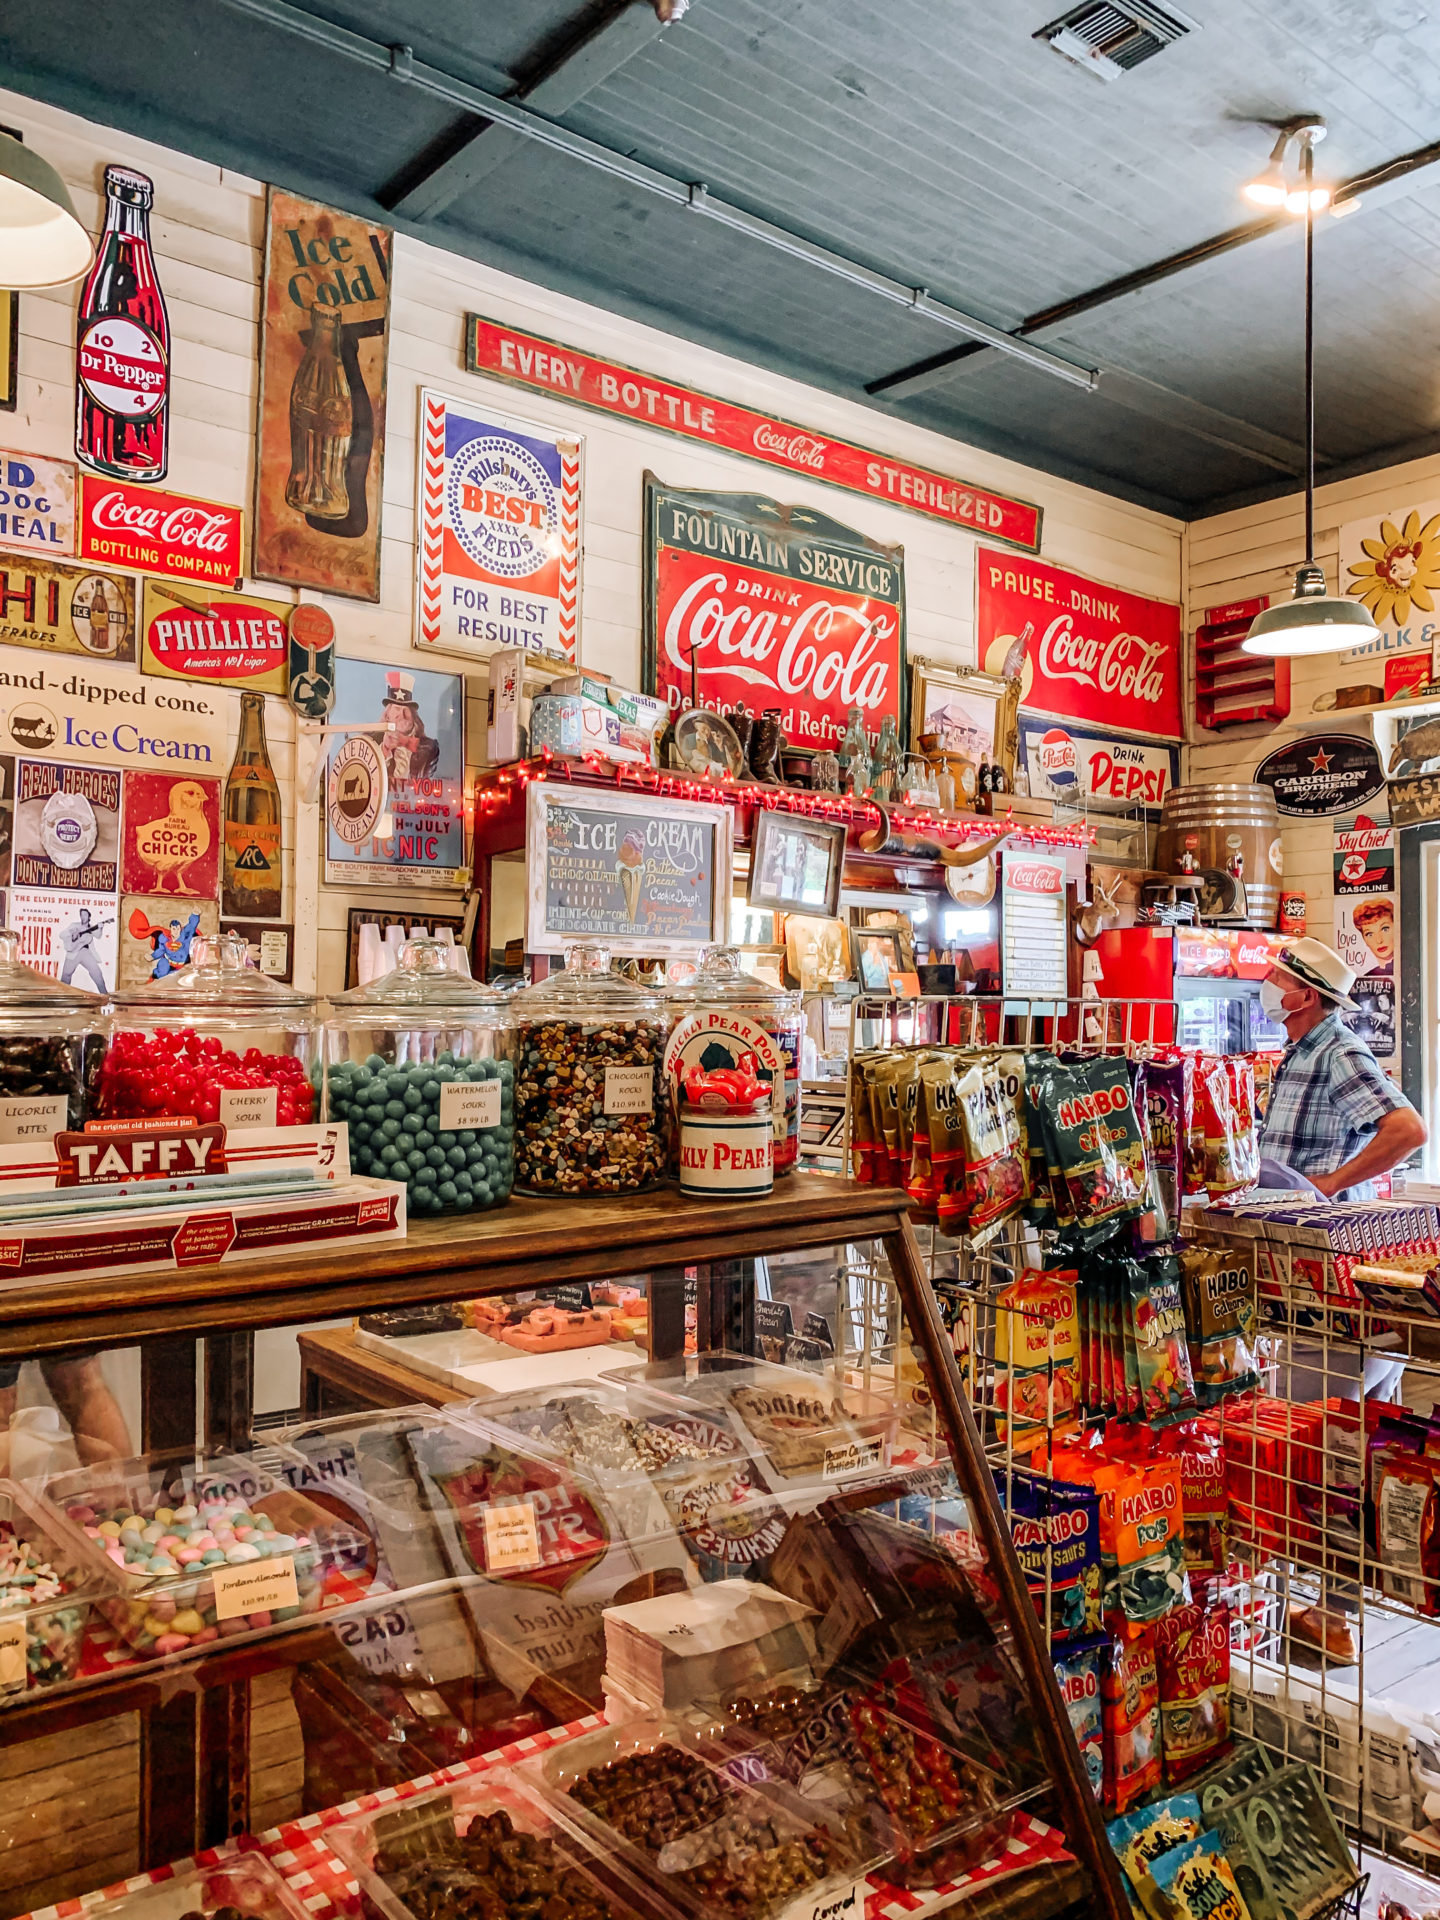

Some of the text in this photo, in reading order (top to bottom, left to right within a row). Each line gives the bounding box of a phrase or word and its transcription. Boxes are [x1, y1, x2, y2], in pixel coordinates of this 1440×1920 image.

[285, 229, 354, 268] Ice
[287, 265, 380, 311] Cold
[94, 333, 113, 347] 10
[141, 341, 152, 354] 2
[80, 352, 164, 384] Dr Pepper
[500, 340, 716, 435] EVERY BOTTLE
[134, 394, 146, 407] 4
[753, 423, 826, 470] Coca-Cola
[467, 457, 537, 502] Pillsbury's
[866, 462, 1003, 528] STERILIZED
[461, 483, 547, 530] BEST
[92, 492, 233, 552] Coca-Cola
[488, 520, 520, 536] XXXX
[472, 523, 534, 559] FEEDS
[90, 537, 232, 577] BOTTLING COMPANY
[671, 510, 892, 597] FOUNTAIN SERVICE
[735, 578, 802, 607] DRINK
[73, 606, 89, 617] ICE
[452, 587, 549, 626] FOR BEST
[155, 619, 285, 651] PHILLIES
[458, 616, 543, 650] RESULTS
[665, 573, 896, 710] Coca-Cola
[183, 656, 267, 670] America's cigar
[1040, 615, 1169, 703] Coca-Cola
[155, 696, 214, 715] cone.
[630, 695, 657, 709] austin
[64, 717, 213, 762] Ice Cream
[332, 741, 377, 777] BLUE BELL
[1113, 746, 1145, 764] DRINK
[1088, 751, 1166, 803] PEPSI
[1274, 770, 1368, 787] GARRISON
[1284, 780, 1358, 793] BROTHERS
[20, 764, 118, 811] REAL HEROES
[413, 778, 443, 798] YOU
[164, 823, 190, 831] BUREAU
[330, 802, 375, 840] ICE CREAM
[415, 822, 450, 834] JULY
[151, 830, 198, 844] CO-OP
[574, 821, 617, 853] ICE
[646, 820, 703, 862] CREAM
[1336, 829, 1392, 852] Sky Chief
[141, 842, 198, 857] CHICKS
[240, 848, 264, 867] RC
[16, 855, 114, 890] DON'T NEED CAPES
[1012, 866, 1057, 890] Coca-Cola
[1339, 884, 1389, 893] GASOLINE
[34, 896, 56, 904] ELVIS
[58, 897, 91, 906] PRESLEY
[93, 899, 115, 907] SHOW
[28, 916, 60, 924] PERSON
[1342, 912, 1345, 928] I
[21, 925, 52, 956] ELVIS
[1187, 945, 1201, 954] ICE
[1337, 930, 1357, 949] Love
[1345, 950, 1367, 966] Lucy
[668, 1014, 777, 1073] PRICKLY PEAR POP
[447, 1085, 498, 1095] WATERMELON
[619, 1086, 643, 1094] ROCKS
[6, 1105, 58, 1117] LICORICE
[229, 1096, 269, 1107] CHERRY
[461, 1101, 486, 1109] SOURS
[103, 1122, 130, 1132] original
[144, 1120, 178, 1129] fashioned
[235, 1112, 262, 1122] SOUR
[17, 1124, 48, 1135] BITES
[69, 1137, 214, 1177] TAFFY
[713, 1143, 765, 1170] PEAR
[361, 1207, 388, 1217] FLAVOR
[312, 1218, 335, 1227] GRAPE
[56, 1252, 83, 1260] VANILLA
[221, 1570, 290, 1592] Jordan Almonds
[813, 1886, 855, 1920] Covered
